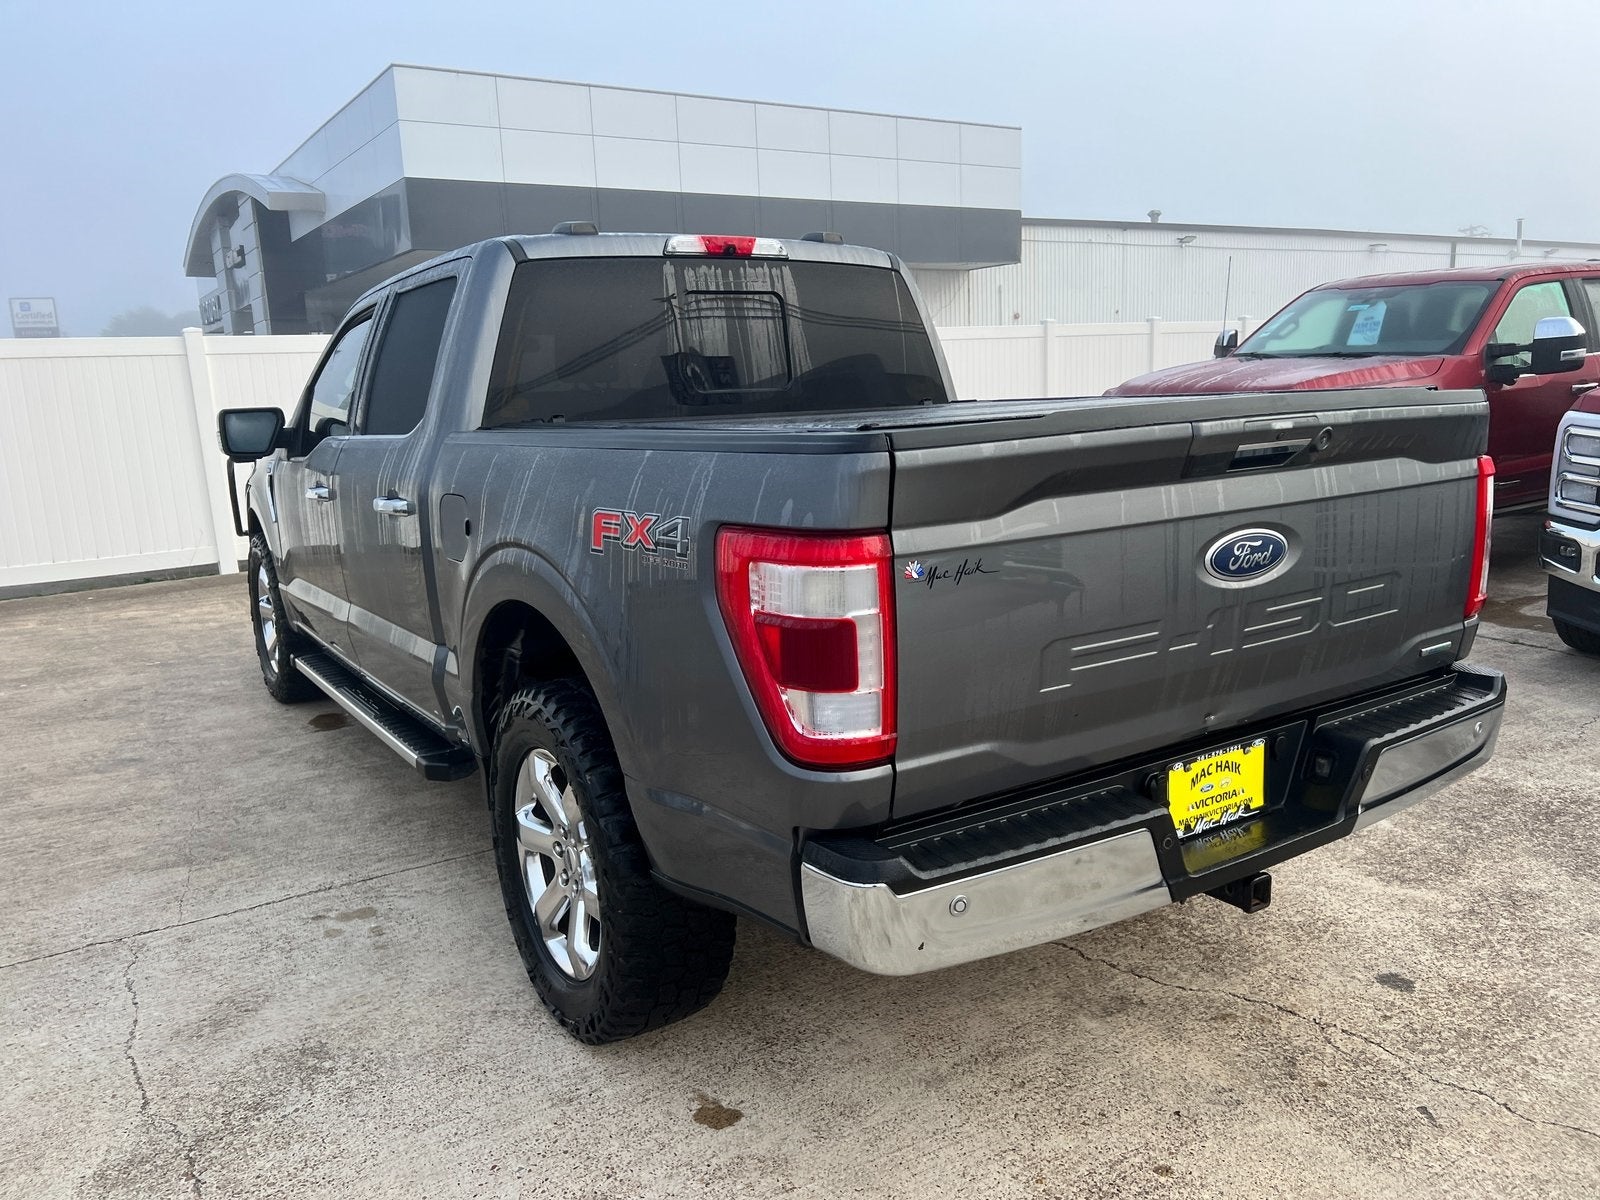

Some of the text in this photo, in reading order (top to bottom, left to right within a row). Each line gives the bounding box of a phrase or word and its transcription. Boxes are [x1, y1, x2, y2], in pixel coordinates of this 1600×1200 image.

[590, 507, 690, 559] FX4
[1229, 539, 1272, 571] Ford
[917, 558, 1000, 590] Mac Haik
[1039, 571, 1402, 693] F-150
[1190, 763, 1213, 790] MAC
[1215, 760, 1242, 776] HAIK
[1194, 789, 1238, 810] VICTORIA
[1191, 804, 1259, 836] Mac Haik
